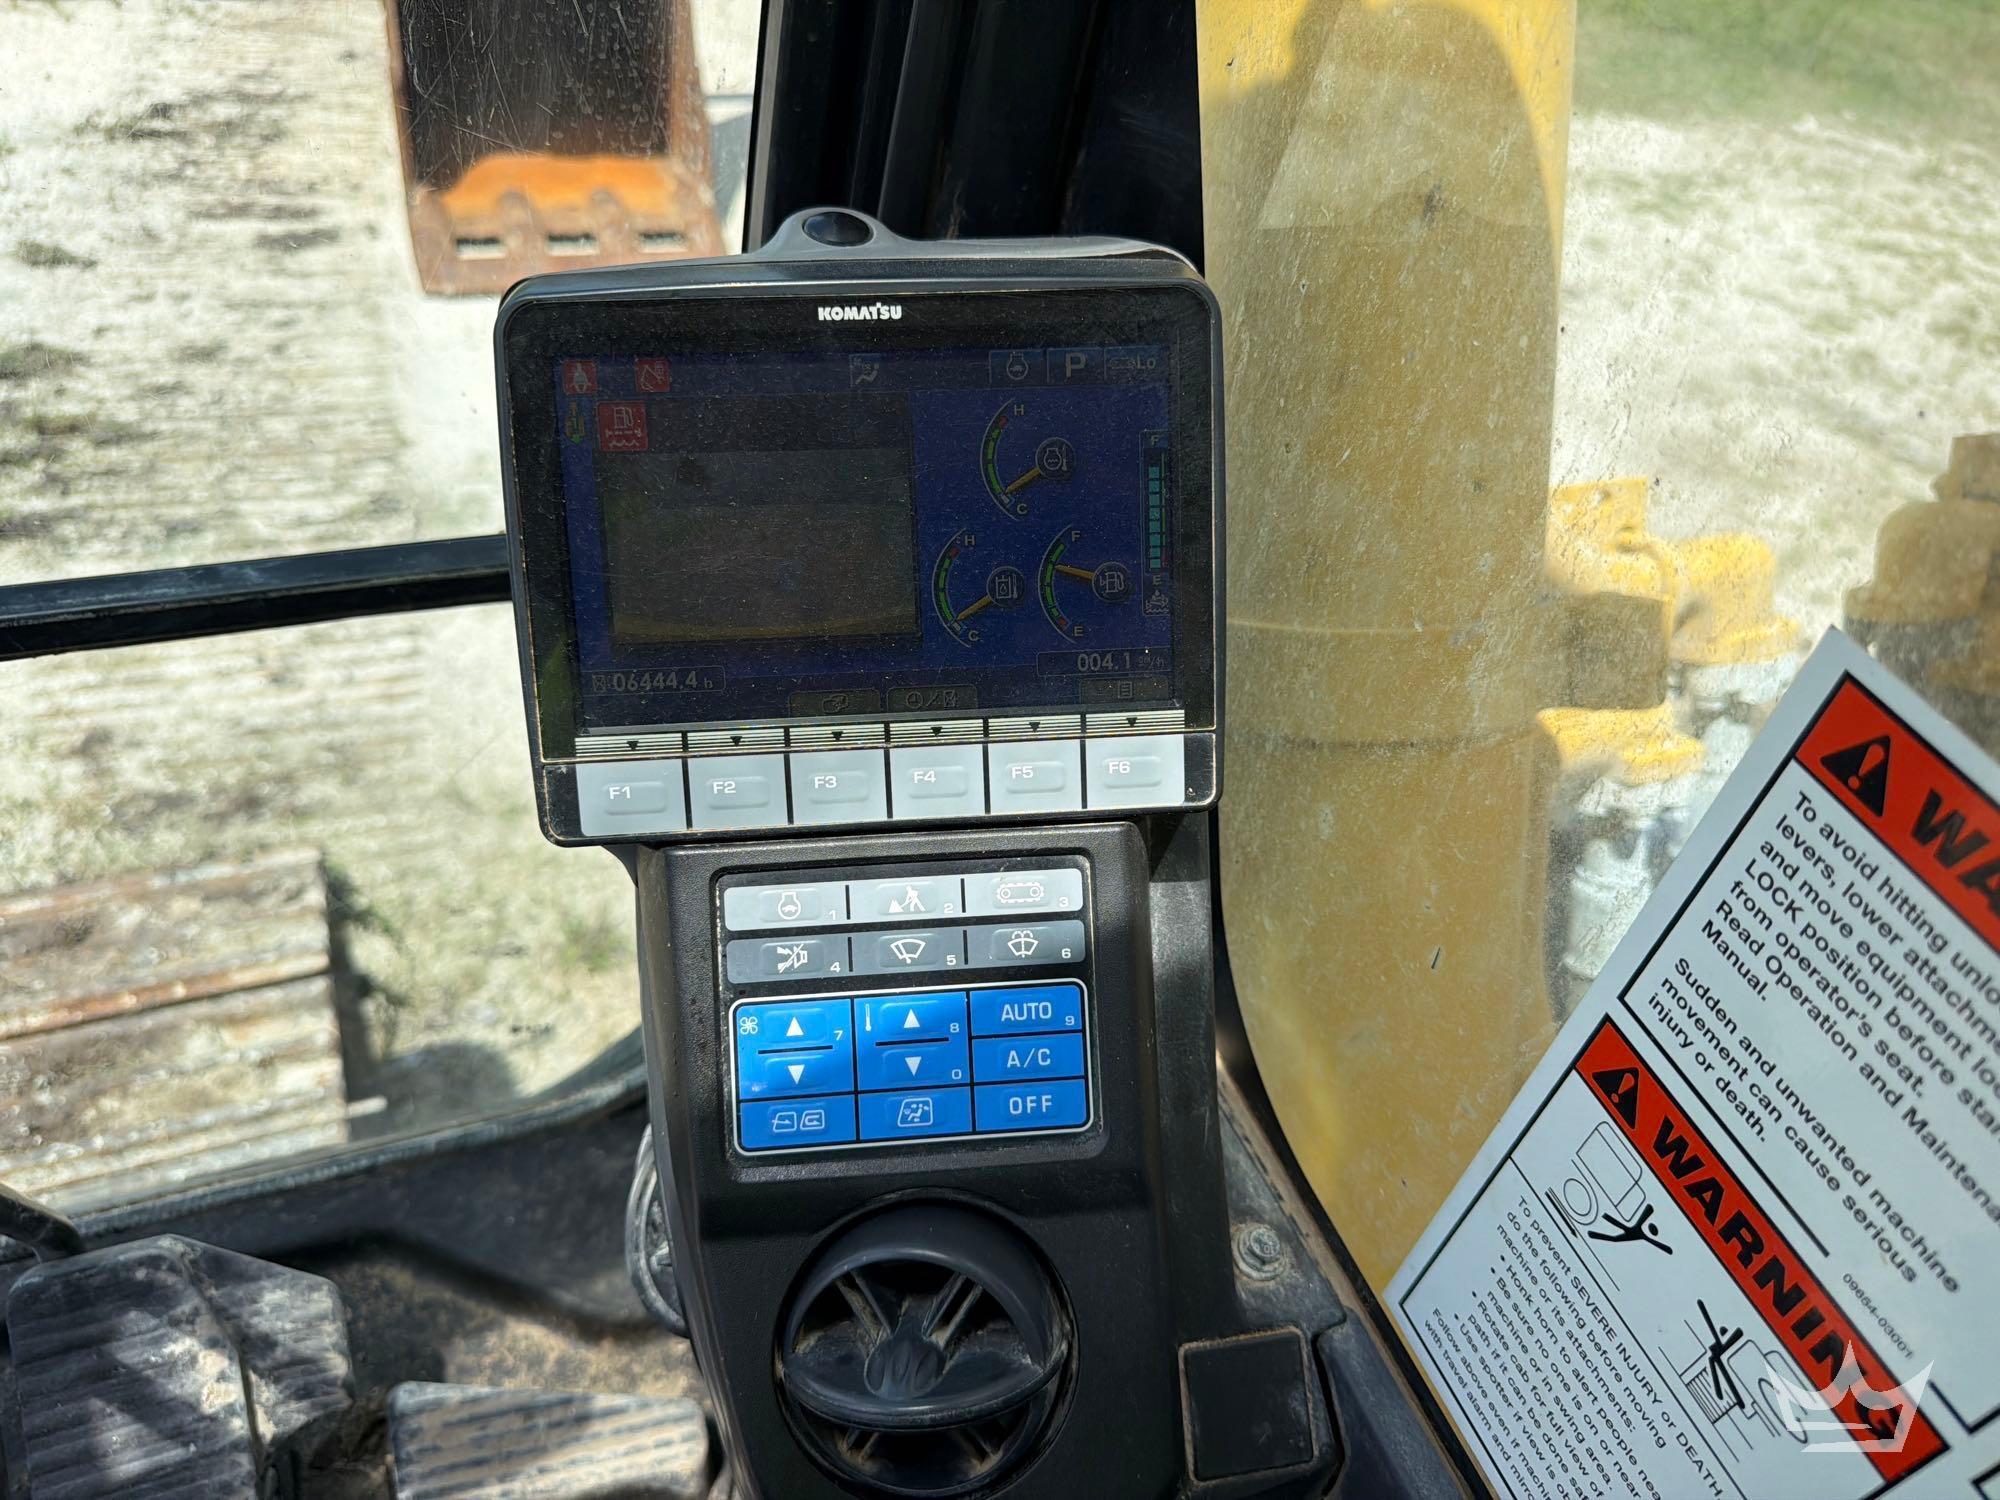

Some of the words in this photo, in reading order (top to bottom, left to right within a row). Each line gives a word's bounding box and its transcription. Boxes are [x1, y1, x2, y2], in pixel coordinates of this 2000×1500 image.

[818, 302, 902, 321] KOMATSU
[1065, 352, 1088, 378] P
[1014, 404, 1025, 416] H
[1016, 503, 1028, 515] C
[964, 535, 975, 546] H
[1071, 531, 1081, 542] F
[968, 630, 979, 641] C
[1073, 626, 1084, 637] E
[1077, 652, 1131, 672] 004.1
[614, 671, 698, 692] 06444.4
[913, 770, 936, 783] F4
[1011, 766, 1034, 779] F5
[1109, 761, 1131, 774] F6
[713, 781, 736, 794] F2
[814, 776, 837, 789] F3
[609, 786, 631, 800] F1
[1776, 814, 1836, 888] levers,
[1842, 882, 1904, 946] lower
[1794, 791, 1817, 822] To
[1819, 822, 1879, 881] avoid
[1877, 876, 1948, 954] hitting
[943, 903, 954, 914] 2
[1059, 897, 1069, 907] 3
[829, 910, 836, 920] 1
[946, 955, 956, 966] 5
[1061, 948, 1071, 959] 6
[1701, 919, 1769, 1001] Manual.
[1760, 841, 1800, 881] and
[1799, 881, 1853, 938] move
[1856, 941, 1971, 1060] equipment
[830, 962, 841, 973] 4
[1745, 859, 1804, 923] LOCK
[1800, 922, 1882, 1010] position
[1884, 1007, 1954, 1084] before
[1730, 881, 1773, 931] from
[1776, 932, 1872, 1038] operator's
[1875, 1039, 1921, 1098] seat.
[1001, 1001, 1052, 1021] AUTO
[1716, 899, 1765, 956] Read
[1766, 955, 1858, 1061] Operation
[1859, 1062, 1904, 1108] and
[950, 1023, 960, 1033] 8
[1065, 1016, 1075, 1026] 9
[834, 1031, 843, 1041] 7
[1006, 1049, 1051, 1069] A/C
[1649, 993, 1694, 1049] injury
[1695, 1052, 1715, 1073] or
[1716, 1076, 1766, 1142] death.
[1009, 1095, 1053, 1115] OFF
[1661, 977, 1748, 1082] movement
[1749, 1082, 1783, 1123] can
[1785, 1125, 1840, 1191] cause
[1842, 1194, 1917, 1282] serious
[1675, 957, 1738, 1035] Sudden
[1739, 1035, 1776, 1077] and
[1776, 1077, 1871, 1187] unwanted
[1869, 1188, 1959, 1293] machine
[1652, 1115, 1904, 1449] WARNING
[1518, 1196, 1531, 1217] To
[1530, 1220, 1571, 1276] prevent
[1571, 1276, 1617, 1341] SEVERE
[1616, 1342, 1663, 1404] INJURY
[1661, 1411, 1677, 1429] or
[1497, 1224, 1538, 1286] machine
[1539, 1288, 1552, 1304] or
[1551, 1305, 1565, 1327] its
[1565, 1330, 1636, 1433] attachments:
[1507, 1211, 1521, 1231] do
[1522, 1232, 1539, 1258] the
[1539, 1259, 1586, 1329] following
[1586, 1330, 1622, 1383] before
[1623, 1387, 1667, 1449] moving
[1506, 1265, 1533, 1307] Honk
[1533, 1307, 1559, 1345] horn
[1559, 1346, 1571, 1364] to
[1572, 1368, 1599, 1406] alert
[1596, 1408, 1638, 1466] people
[1433, 1308, 1461, 1353] Follow
[1461, 1356, 1488, 1399] above
[1488, 1402, 1511, 1437] even
[1510, 1437, 1521, 1449] if
[1496, 1277, 1511, 1300] Be
[1512, 1302, 1534, 1336] sure
[1534, 1339, 1549, 1359] no
[1550, 1362, 1571, 1393] one
[1572, 1394, 1582, 1410] is
[1583, 1414, 1599, 1436] on
[1600, 1440, 1614, 1456] or
[1613, 1461, 1641, 1498] near
[1424, 1320, 1443, 1349] with
[1443, 1350, 1468, 1389] travel
[1466, 1391, 1493, 1431] alarm
[1492, 1433, 1512, 1462] and
[1460, 1323, 1478, 1353] Use
[1478, 1356, 1513, 1409] spotter
[1513, 1411, 1524, 1424] if
[1522, 1425, 1546, 1461] view
[1545, 1464, 1556, 1479] is
[1468, 1314, 1491, 1348] path
[1491, 1348, 1501, 1360] if
[1499, 1362, 1508, 1375] it
[1508, 1377, 1527, 1406] can
[1527, 1407, 1541, 1429] be
[1542, 1433, 1569, 1474] done
[1477, 1301, 1509, 1351] Rotate
[1510, 1354, 1530, 1383] cab
[1530, 1385, 1547, 1408] for
[1546, 1411, 1565, 1437] full
[1564, 1439, 1590, 1476] view
[1590, 1481, 1604, 1498] of
[1487, 1291, 1528, 1355] machine
[1529, 1357, 1542, 1374] or
[1541, 1375, 1553, 1393] in
[1553, 1395, 1585, 1444] swing
[1586, 1447, 1612, 1491] area.
